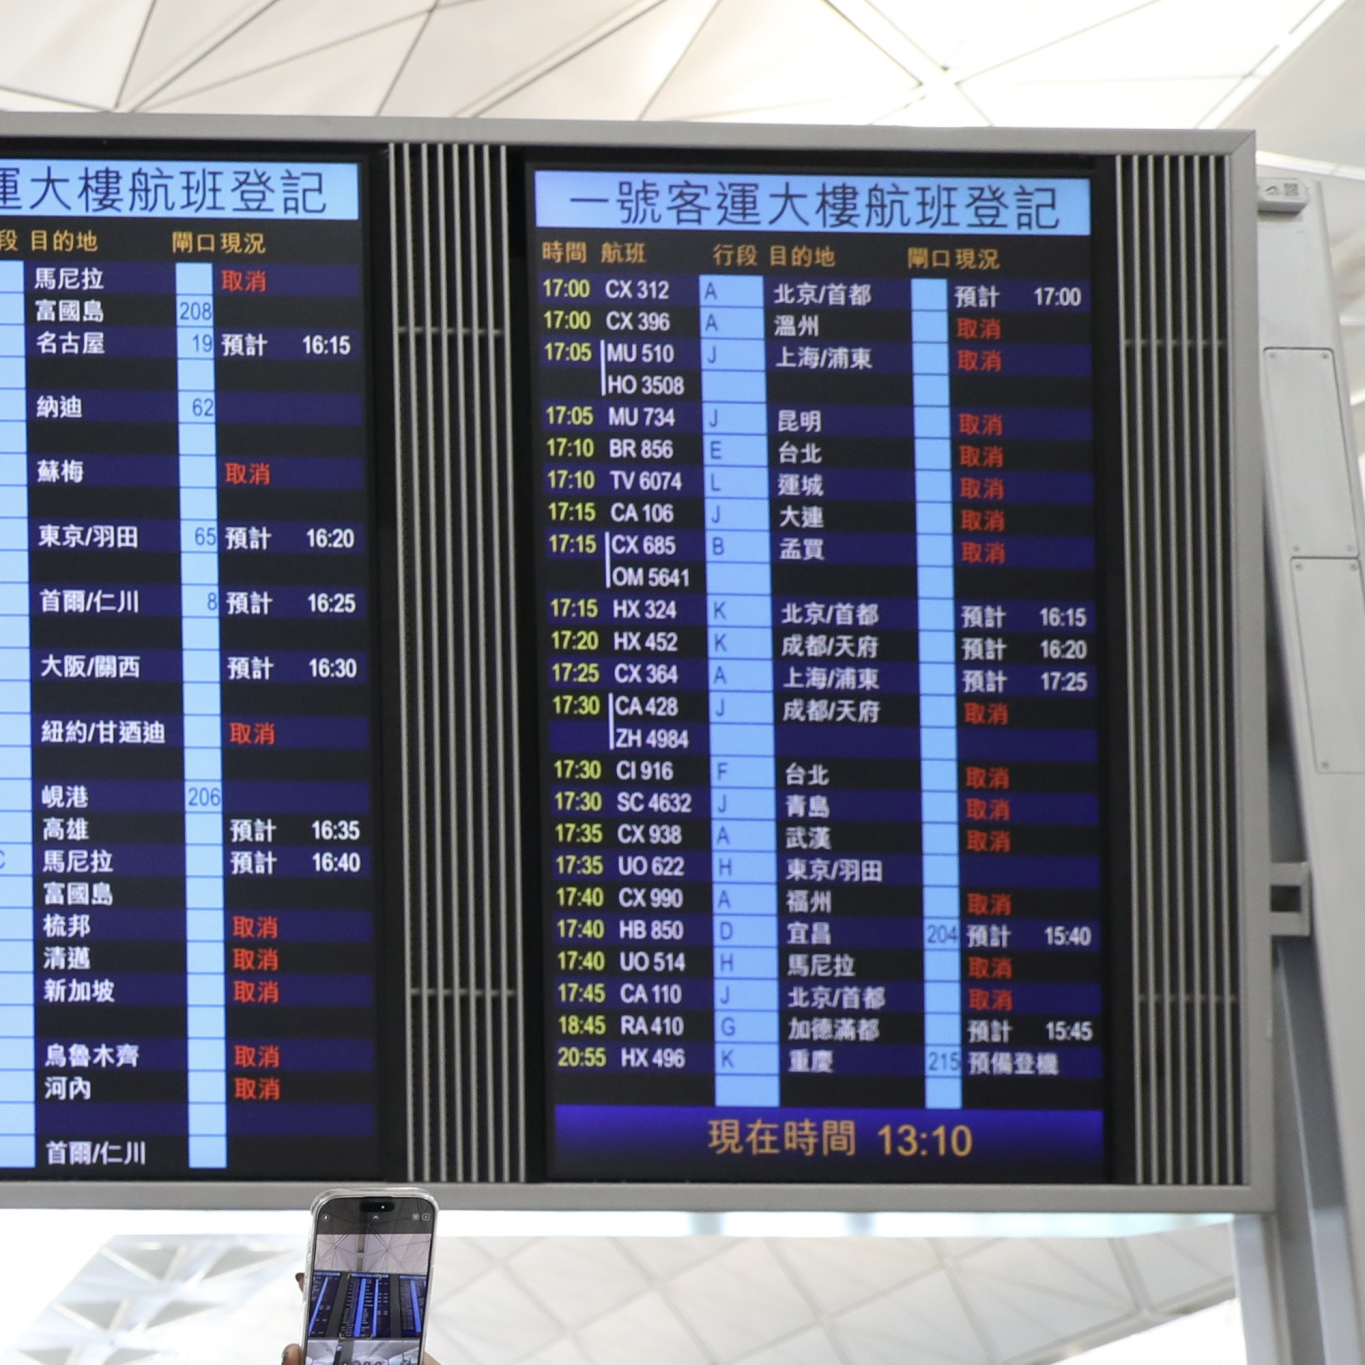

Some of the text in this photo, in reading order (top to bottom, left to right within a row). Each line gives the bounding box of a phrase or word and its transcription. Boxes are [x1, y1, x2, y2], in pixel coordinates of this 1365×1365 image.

[569, 180, 1061, 231] 一號客運大樓航班登記
[31, 229, 98, 252] 目的地
[220, 232, 266, 255] 現況
[541, 240, 587, 264] 時間
[600, 241, 646, 264] 航班
[713, 243, 758, 267] 行段
[770, 245, 836, 268] 目的地
[955, 248, 1000, 270] 現況
[543, 278, 1082, 309] 17:00 CX 312 A 北京/首都 預計 17:00
[179, 301, 213, 321] 208
[38, 523, 138, 549] 東京/羽田
[194, 526, 217, 546] 65
[224, 526, 272, 550] 預計
[306, 528, 355, 549] 16:20
[549, 533, 597, 554] 17:15
[611, 534, 639, 555] CX
[642, 535, 677, 556] 685
[712, 536, 725, 556] B
[961, 541, 1006, 564] 取消
[43, 978, 115, 1003] 新加坡
[233, 980, 279, 1003] 取消
[557, 1046, 607, 1068] 20:55
[621, 1047, 649, 1068] HX
[651, 1047, 686, 1069] 496
[721, 1049, 734, 1068] K
[928, 1051, 960, 1073] 215
[968, 1051, 1059, 1076] 預備登機
[707, 1118, 973, 1157] 現在時間 13:10
